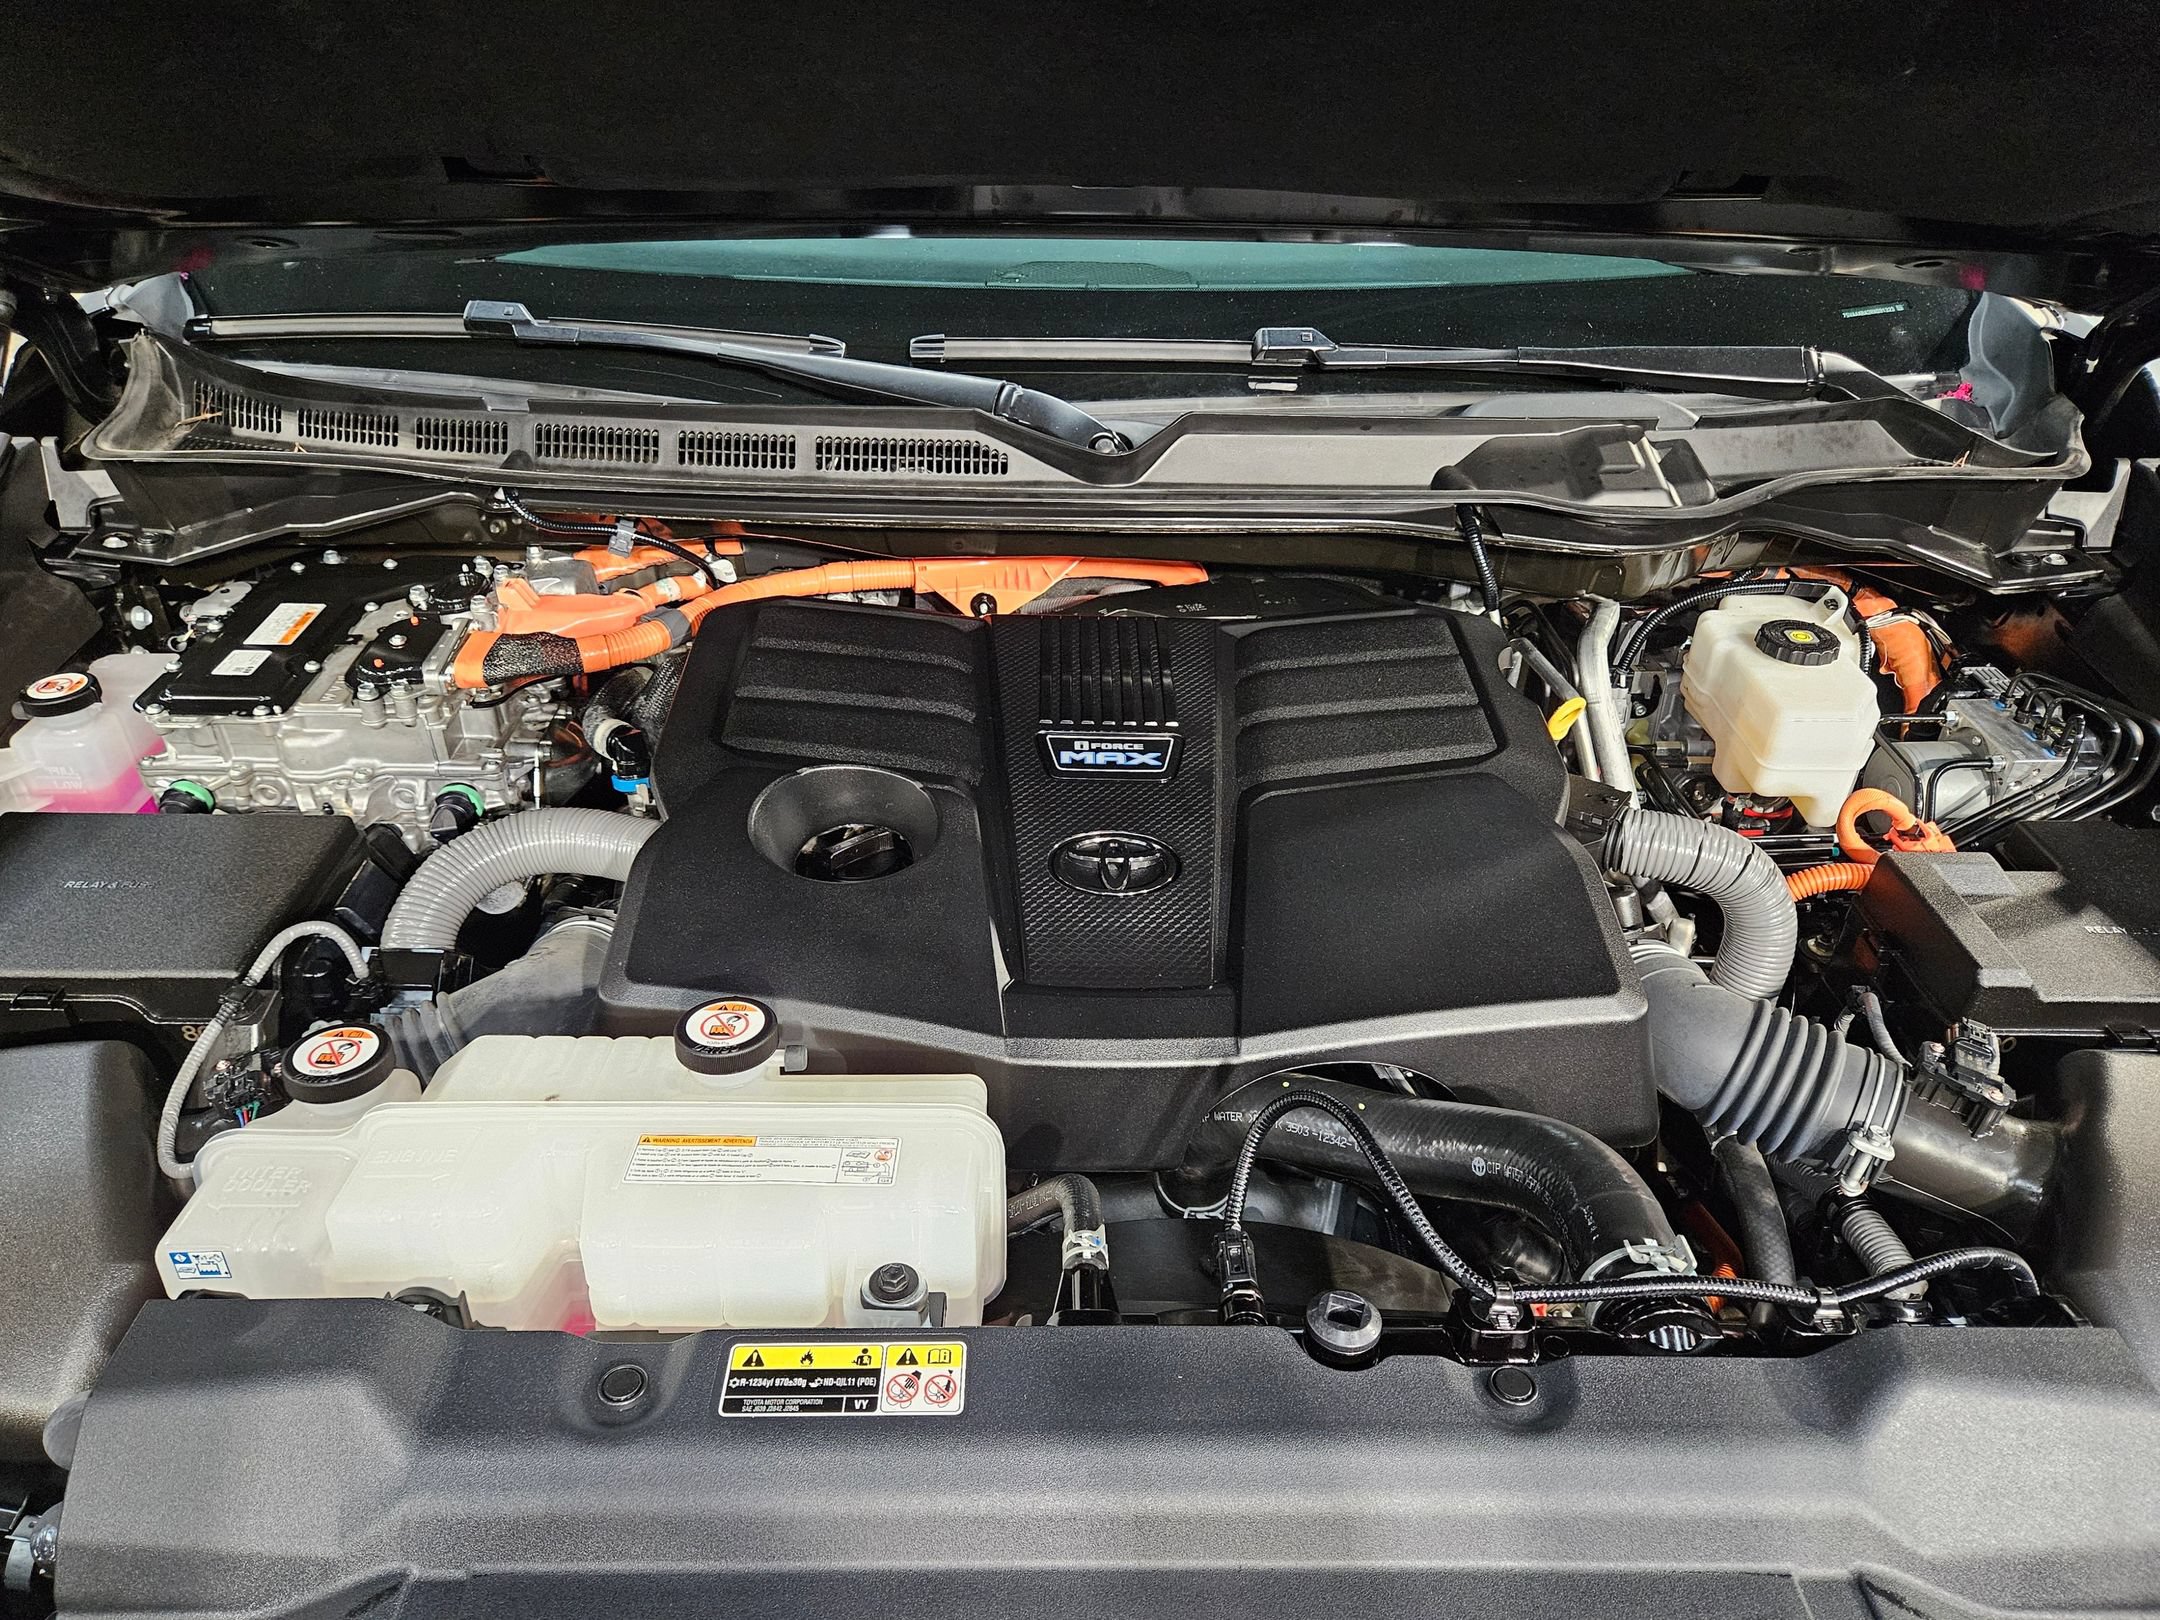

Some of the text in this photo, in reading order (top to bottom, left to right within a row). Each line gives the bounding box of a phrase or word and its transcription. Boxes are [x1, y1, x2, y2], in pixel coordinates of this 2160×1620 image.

[1091, 742, 1145, 750] FORCE
[1060, 751, 1163, 766] MAX
[64, 880, 107, 889] RELAY
[2083, 925, 2128, 935] RELAY
[1214, 1111, 1243, 1122] WATER
[739, 1377, 773, 1389] R-1234yf
[856, 1376, 876, 1387] (POE)
[854, 1399, 869, 1410] VY
